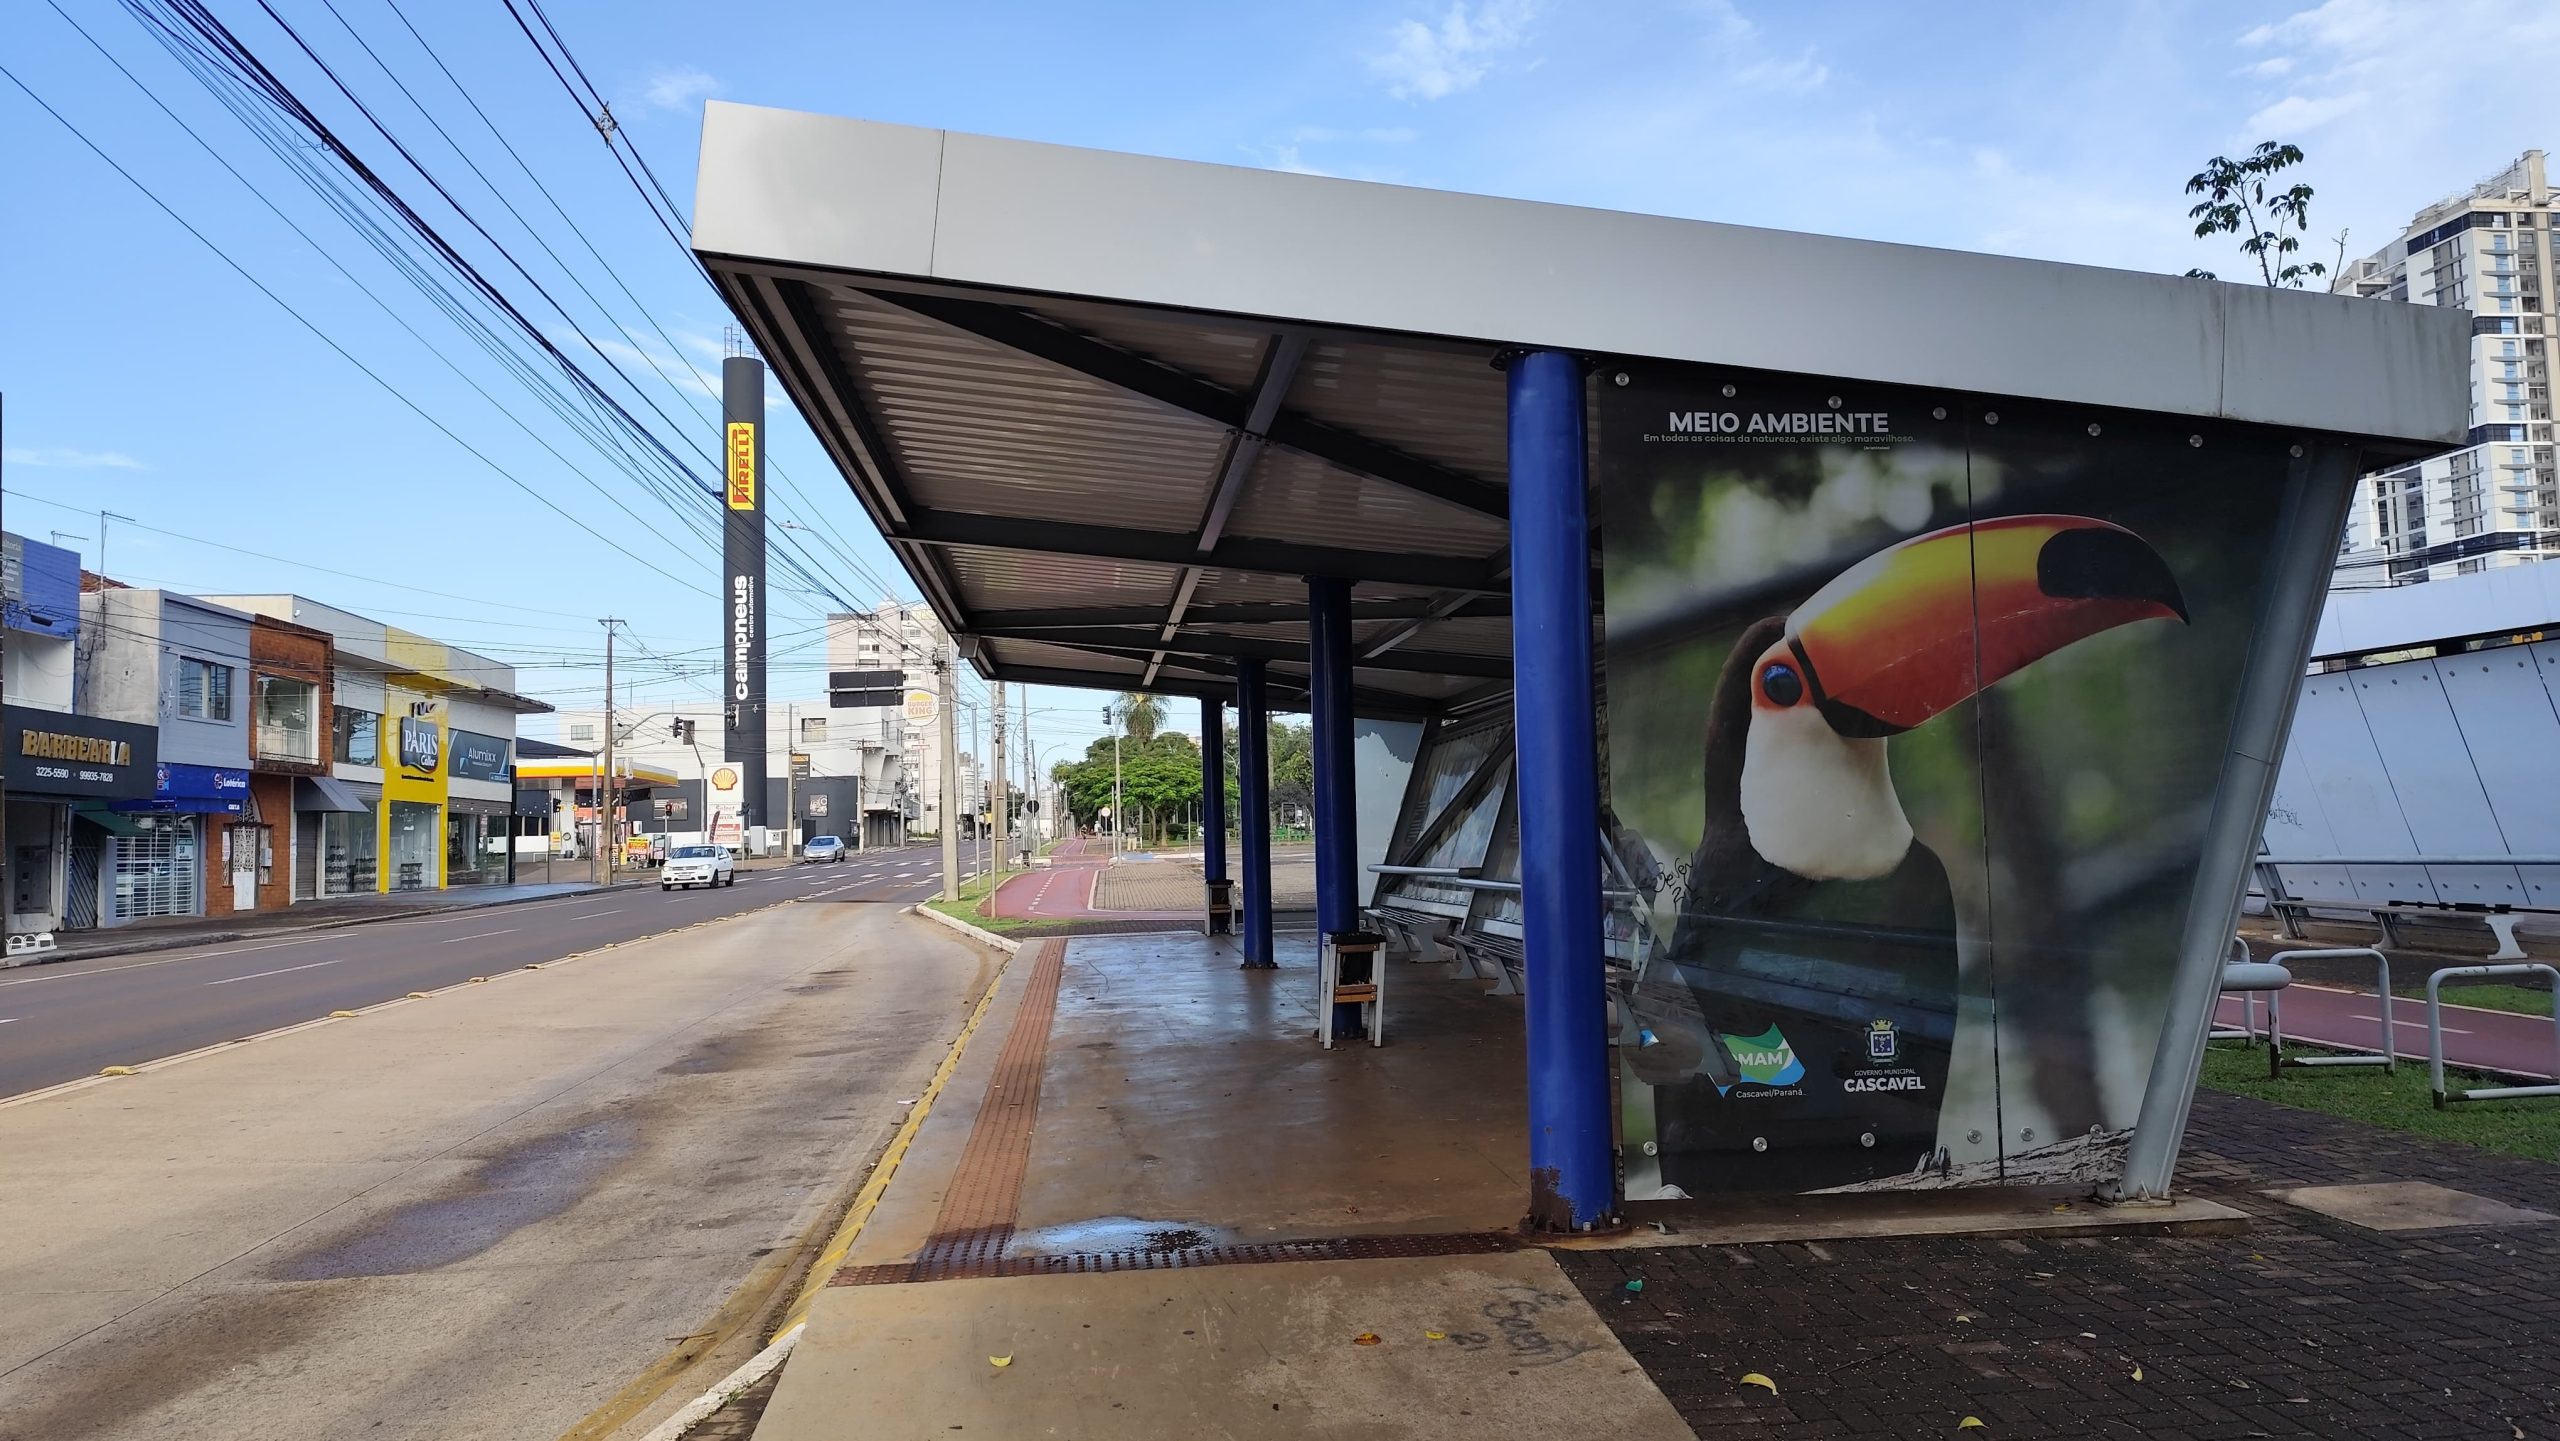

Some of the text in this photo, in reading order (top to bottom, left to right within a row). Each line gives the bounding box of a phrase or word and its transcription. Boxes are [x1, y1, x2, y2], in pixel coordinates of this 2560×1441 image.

[1669, 411, 1889, 433] MEIO AMBIENTE
[1643, 433, 1917, 444] Em todas as coisas da natureza, existe algo maravilhoso.
[732, 429, 749, 503] PIRELLI
[734, 575, 751, 700] campneus
[907, 707, 933, 715] KING
[21, 729, 131, 766] BARBEARIA
[404, 729, 438, 756] PARIS
[467, 747, 497, 763] Alumixx
[35, 766, 69, 779] 3225-5590
[223, 777, 246, 788] Lotérica
[1854, 1067, 1916, 1077] GOVERNO MUNICIPAL
[1843, 1076, 1926, 1093] CASCAVEL
[1735, 1088, 1803, 1099] Cascavel/Paraná
